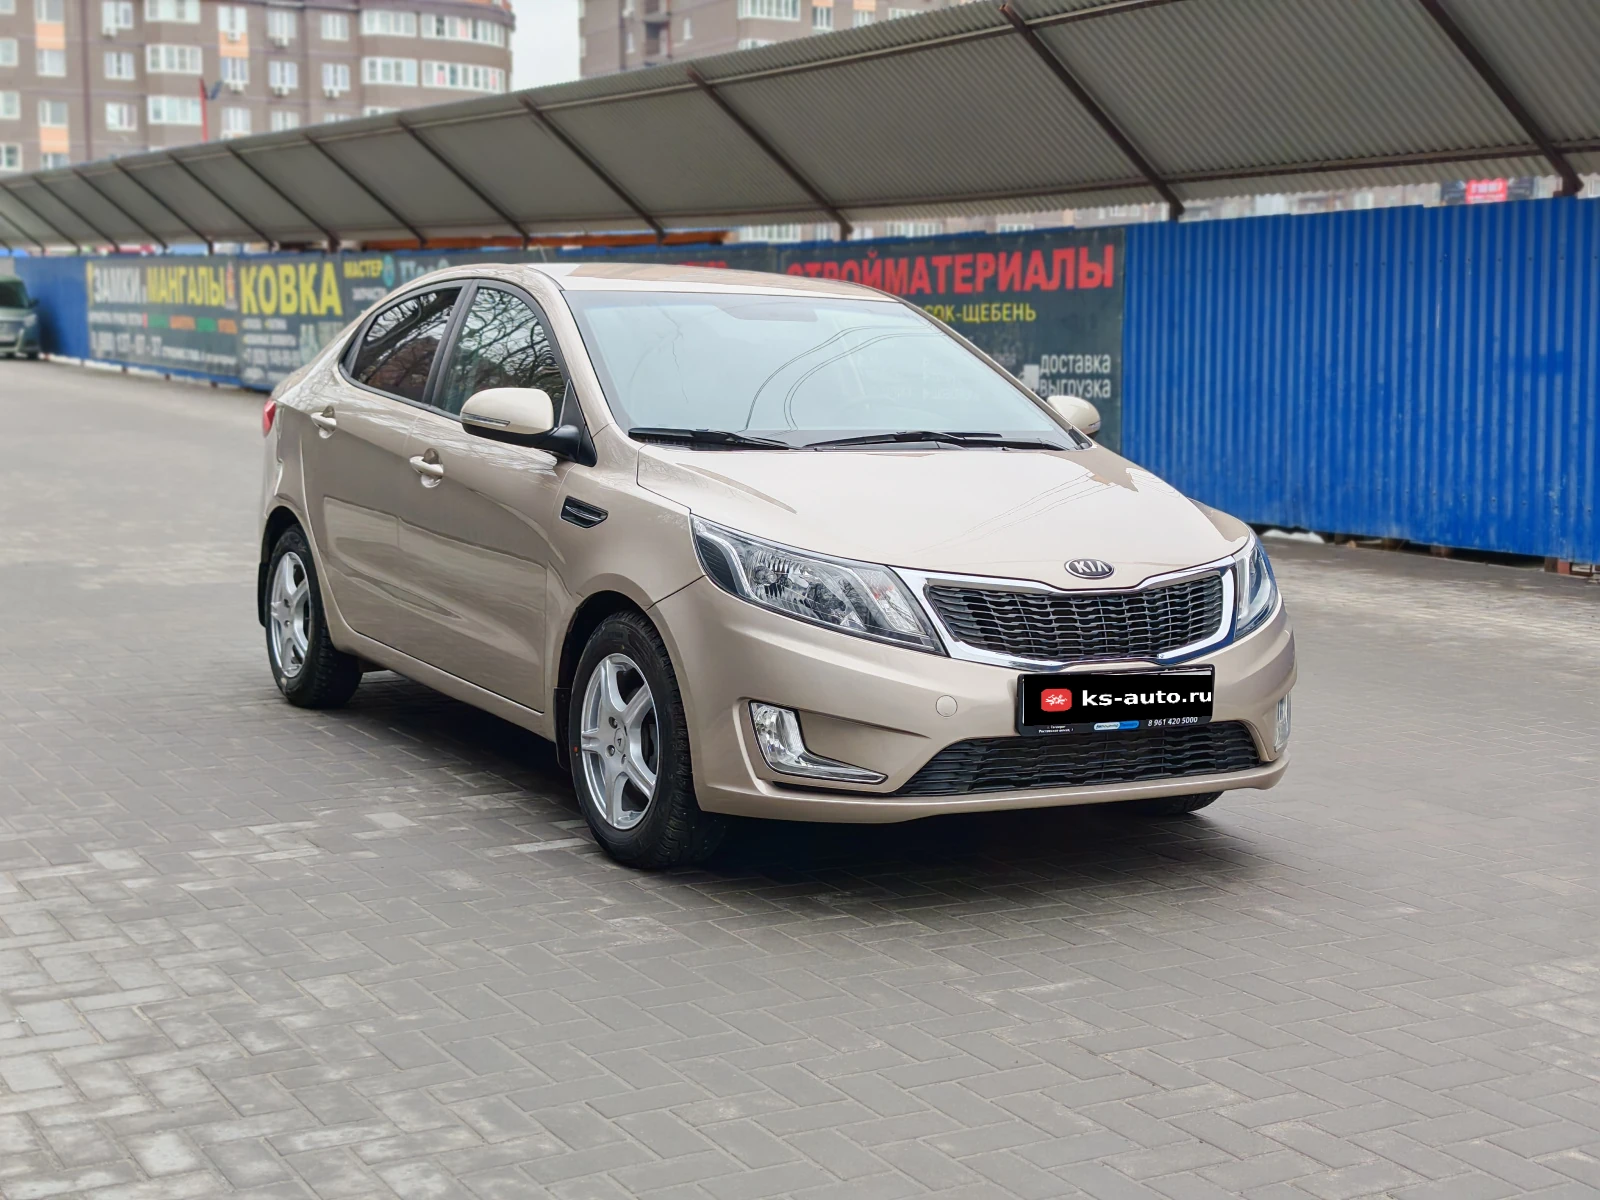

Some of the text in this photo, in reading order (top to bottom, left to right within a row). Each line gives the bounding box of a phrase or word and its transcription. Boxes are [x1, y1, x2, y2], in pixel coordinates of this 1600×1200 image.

[147, 265, 226, 306] МАНГАЛЫ
[239, 261, 343, 315] КОВКА
[1072, 560, 1110, 573] KIA
[1147, 719, 1153, 727] 8
[1153, 718, 1166, 727] 961
[1167, 717, 1181, 725] 420
[1181, 716, 1198, 724] 5000
